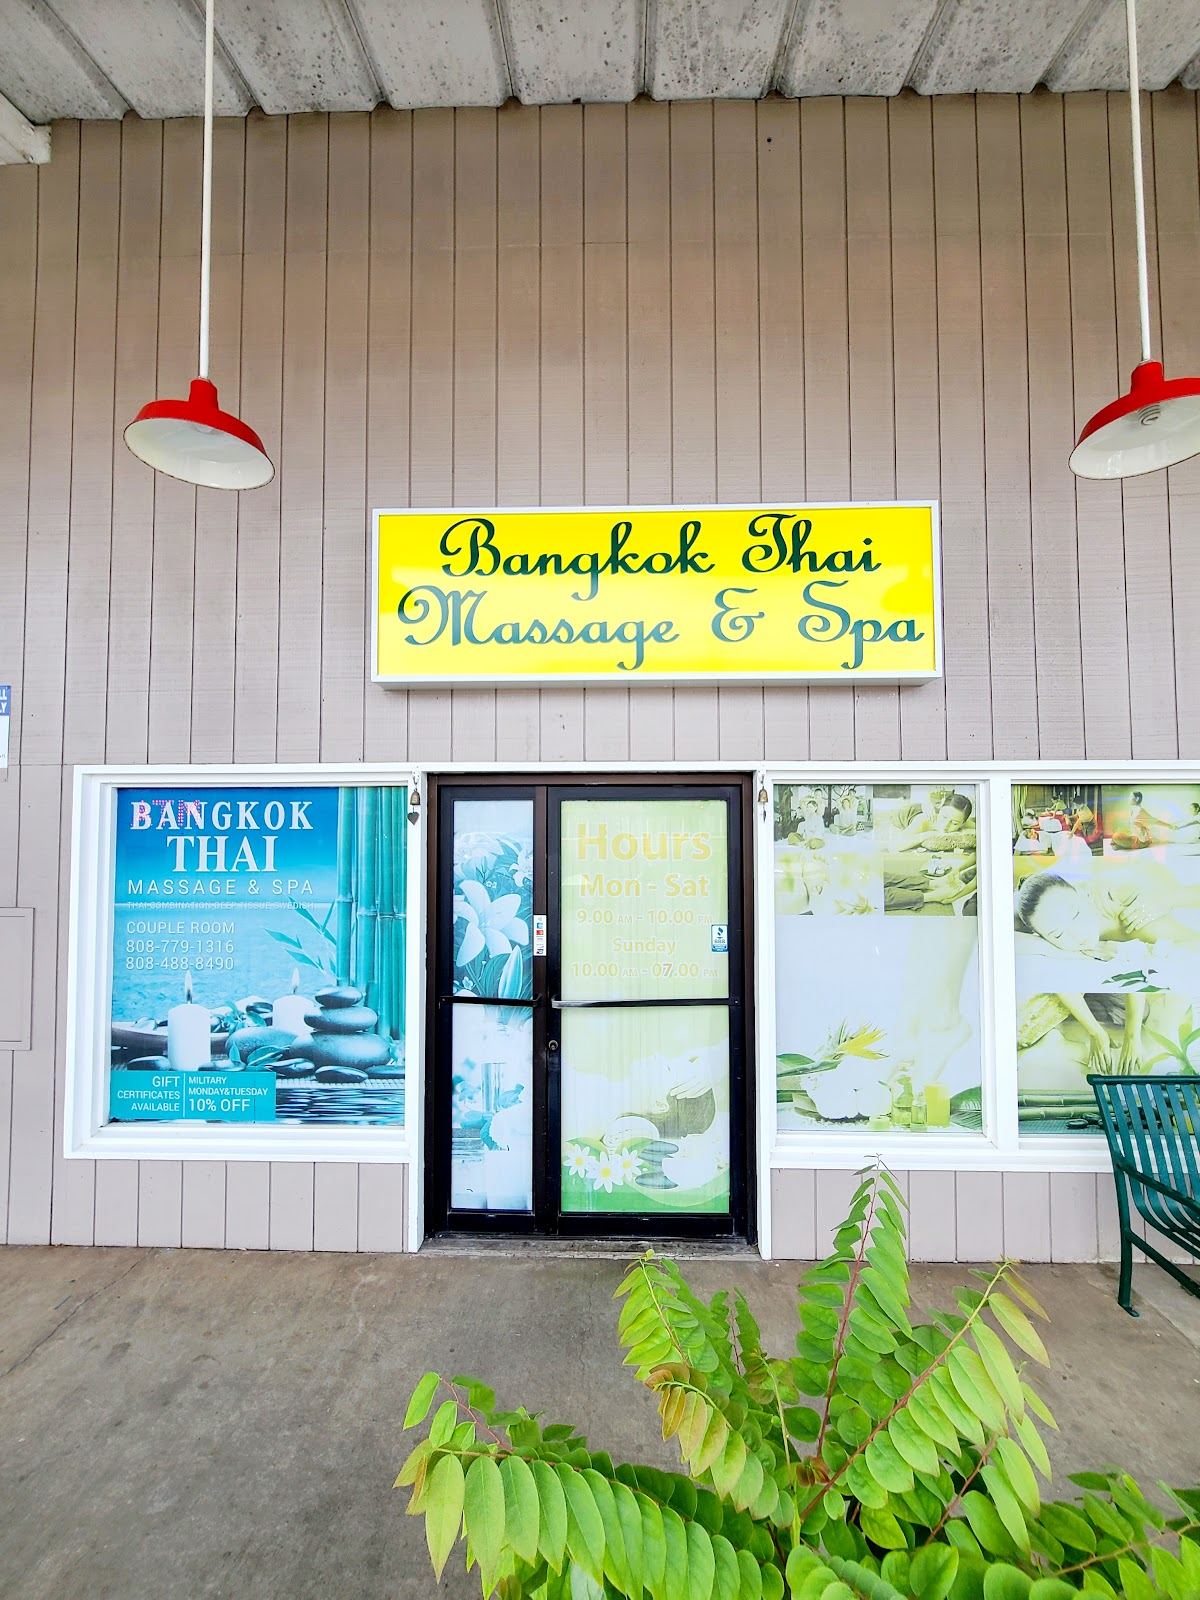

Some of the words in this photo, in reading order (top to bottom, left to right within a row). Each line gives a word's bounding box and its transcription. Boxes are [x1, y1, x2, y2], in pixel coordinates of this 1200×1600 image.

[439, 517, 715, 601] Bangkok
[741, 513, 882, 573] Thai
[397, 585, 679, 670] Massage
[711, 587, 765, 642] &
[798, 580, 925, 670] Spa
[130, 801, 313, 830] BANGKOK
[577, 823, 712, 861] Hours
[166, 835, 278, 872] THAI
[128, 879, 236, 895] MASSAGE
[248, 879, 260, 895] &
[272, 879, 313, 895] SPA
[580, 874, 641, 897] Mon
[665, 873, 709, 897] Sat
[577, 910, 613, 923] 9.00
[618, 915, 633, 923] AM
[647, 910, 694, 923] 10.00
[126, 921, 185, 934] COUPLE
[190, 921, 235, 934] ROOM
[126, 939, 234, 953] 808-779-1316
[612, 937, 676, 954] Sunday
[126, 956, 234, 970] 808-488-8490
[572, 963, 618, 977] 10.00
[622, 969, 638, 977] AM
[652, 963, 699, 977] 07.00
[703, 969, 719, 977] PM
[152, 1076, 180, 1088] GIFT
[188, 1076, 227, 1085] MILITARY
[117, 1091, 181, 1100] CERTIFICATES
[188, 1087, 268, 1096] MONDAY&TUESDAY
[131, 1102, 180, 1112] AVAILABLE
[188, 1098, 217, 1112] 10%
[220, 1098, 250, 1112] OFF
